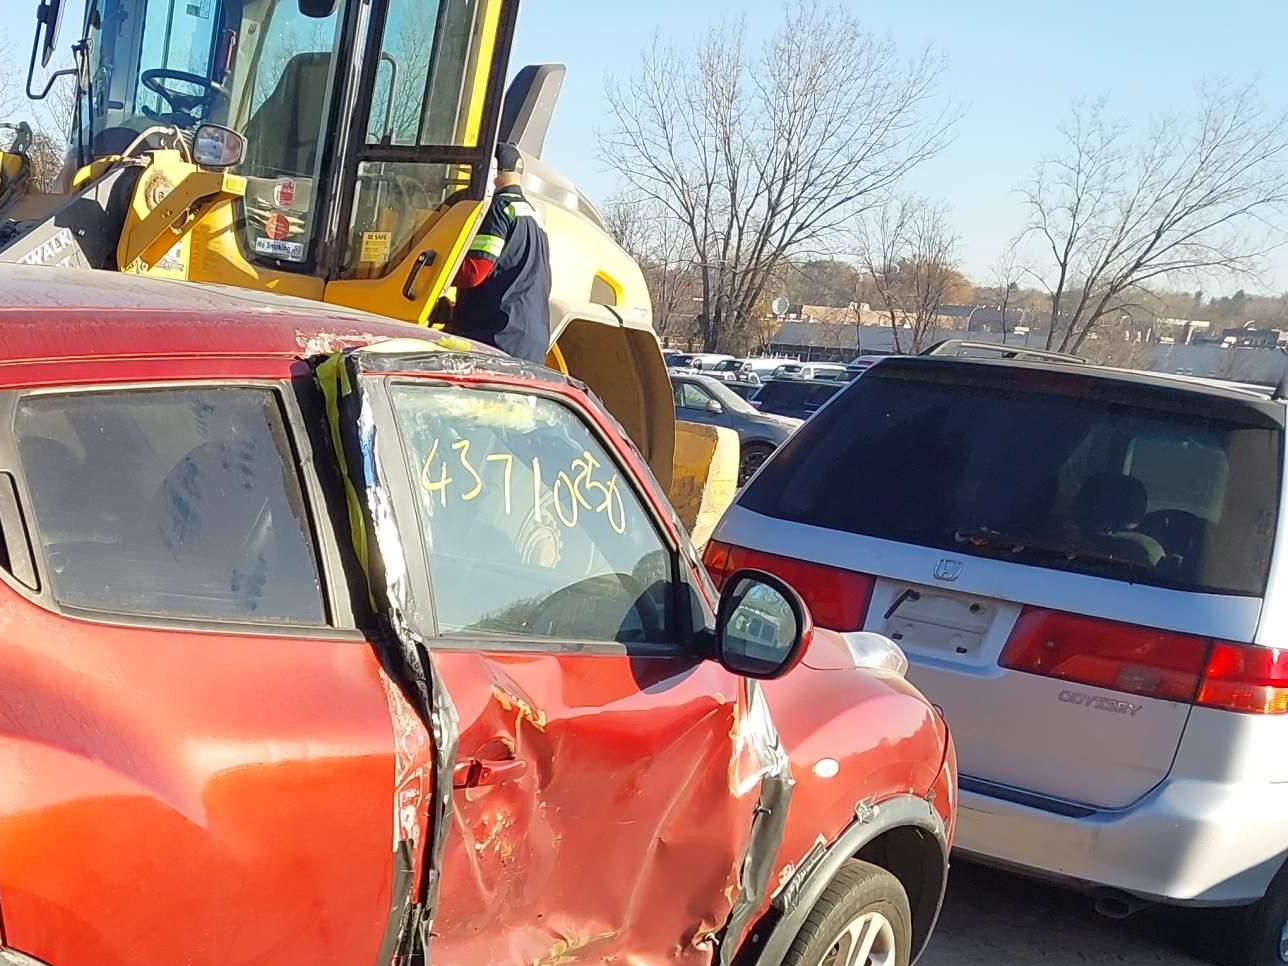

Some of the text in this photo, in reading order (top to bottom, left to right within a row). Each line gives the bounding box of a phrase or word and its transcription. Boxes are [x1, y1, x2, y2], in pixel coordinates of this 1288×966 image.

[256, 240, 265, 248] No
[266, 241, 291, 253] Smoking
[1058, 690, 1143, 716] ODYSSEY
